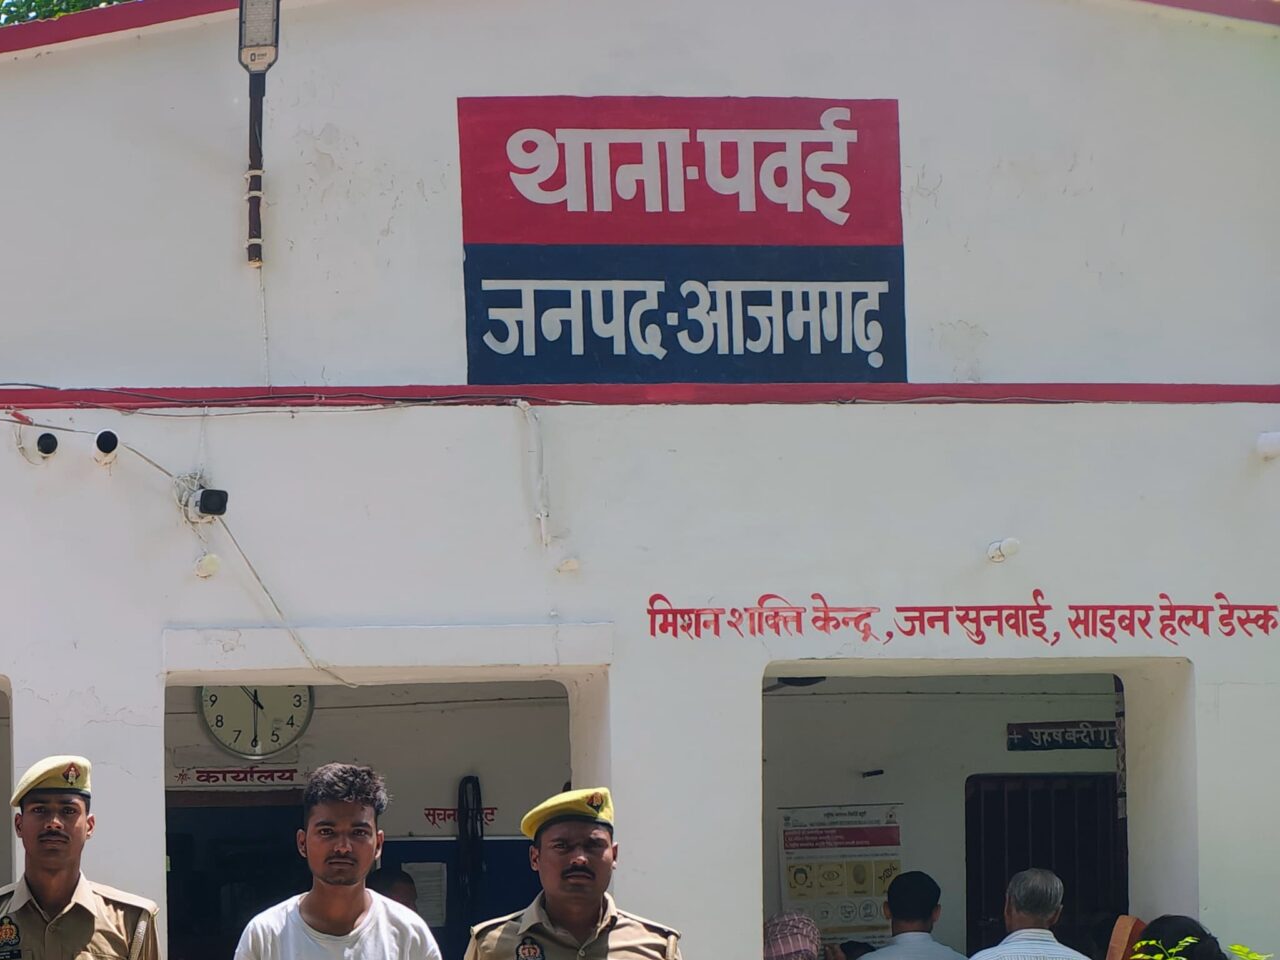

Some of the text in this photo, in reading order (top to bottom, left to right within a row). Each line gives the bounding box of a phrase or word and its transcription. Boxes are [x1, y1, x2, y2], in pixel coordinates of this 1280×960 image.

[647, 593, 726, 640] मिशन
[727, 593, 806, 640] शक्ति
[1068, 604, 1155, 644] साइबर
[1158, 593, 1215, 646] हेल्प
[1214, 592, 1279, 638] डेस्क
[209, 694, 218, 708] 9
[293, 694, 302, 708] 3
[215, 714, 224, 728] 8
[286, 714, 295, 728] 4
[233, 730, 242, 744] 7
[270, 730, 280, 743] 5
[195, 765, 298, 784] कार्यालय
